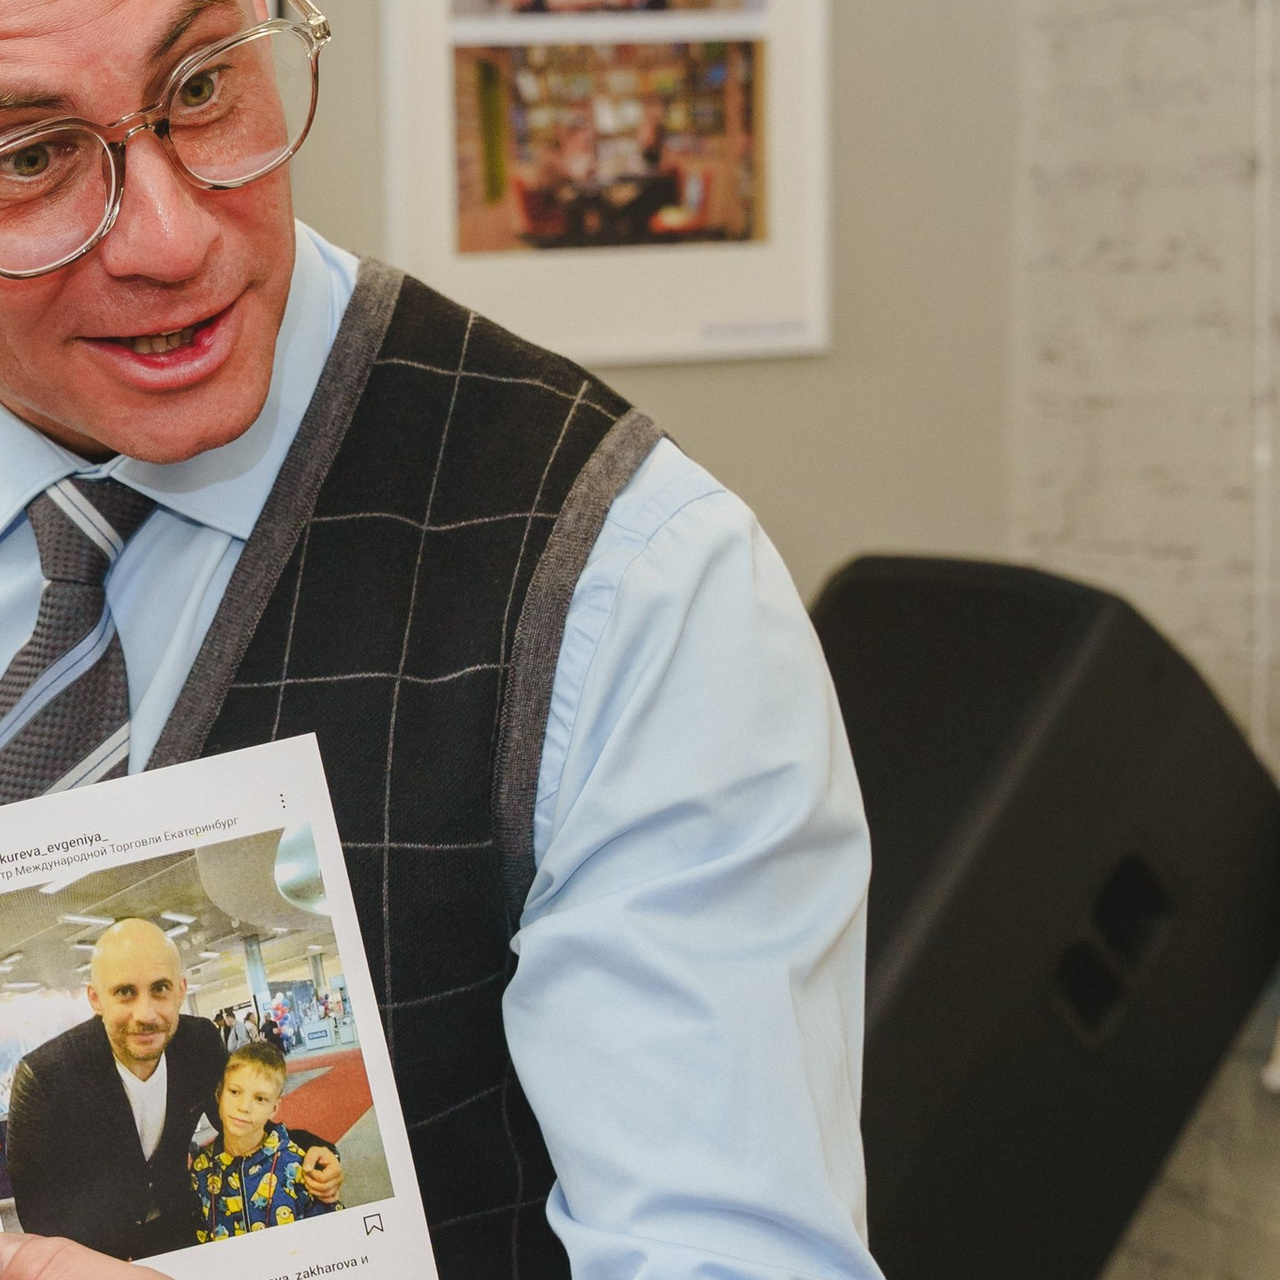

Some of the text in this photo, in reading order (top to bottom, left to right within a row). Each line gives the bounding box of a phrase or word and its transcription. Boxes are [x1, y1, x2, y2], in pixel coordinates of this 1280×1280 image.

[15, 844, 108, 876] Международной
[110, 833, 162, 855] Торговли
[164, 816, 239, 842] Екатеринбург
